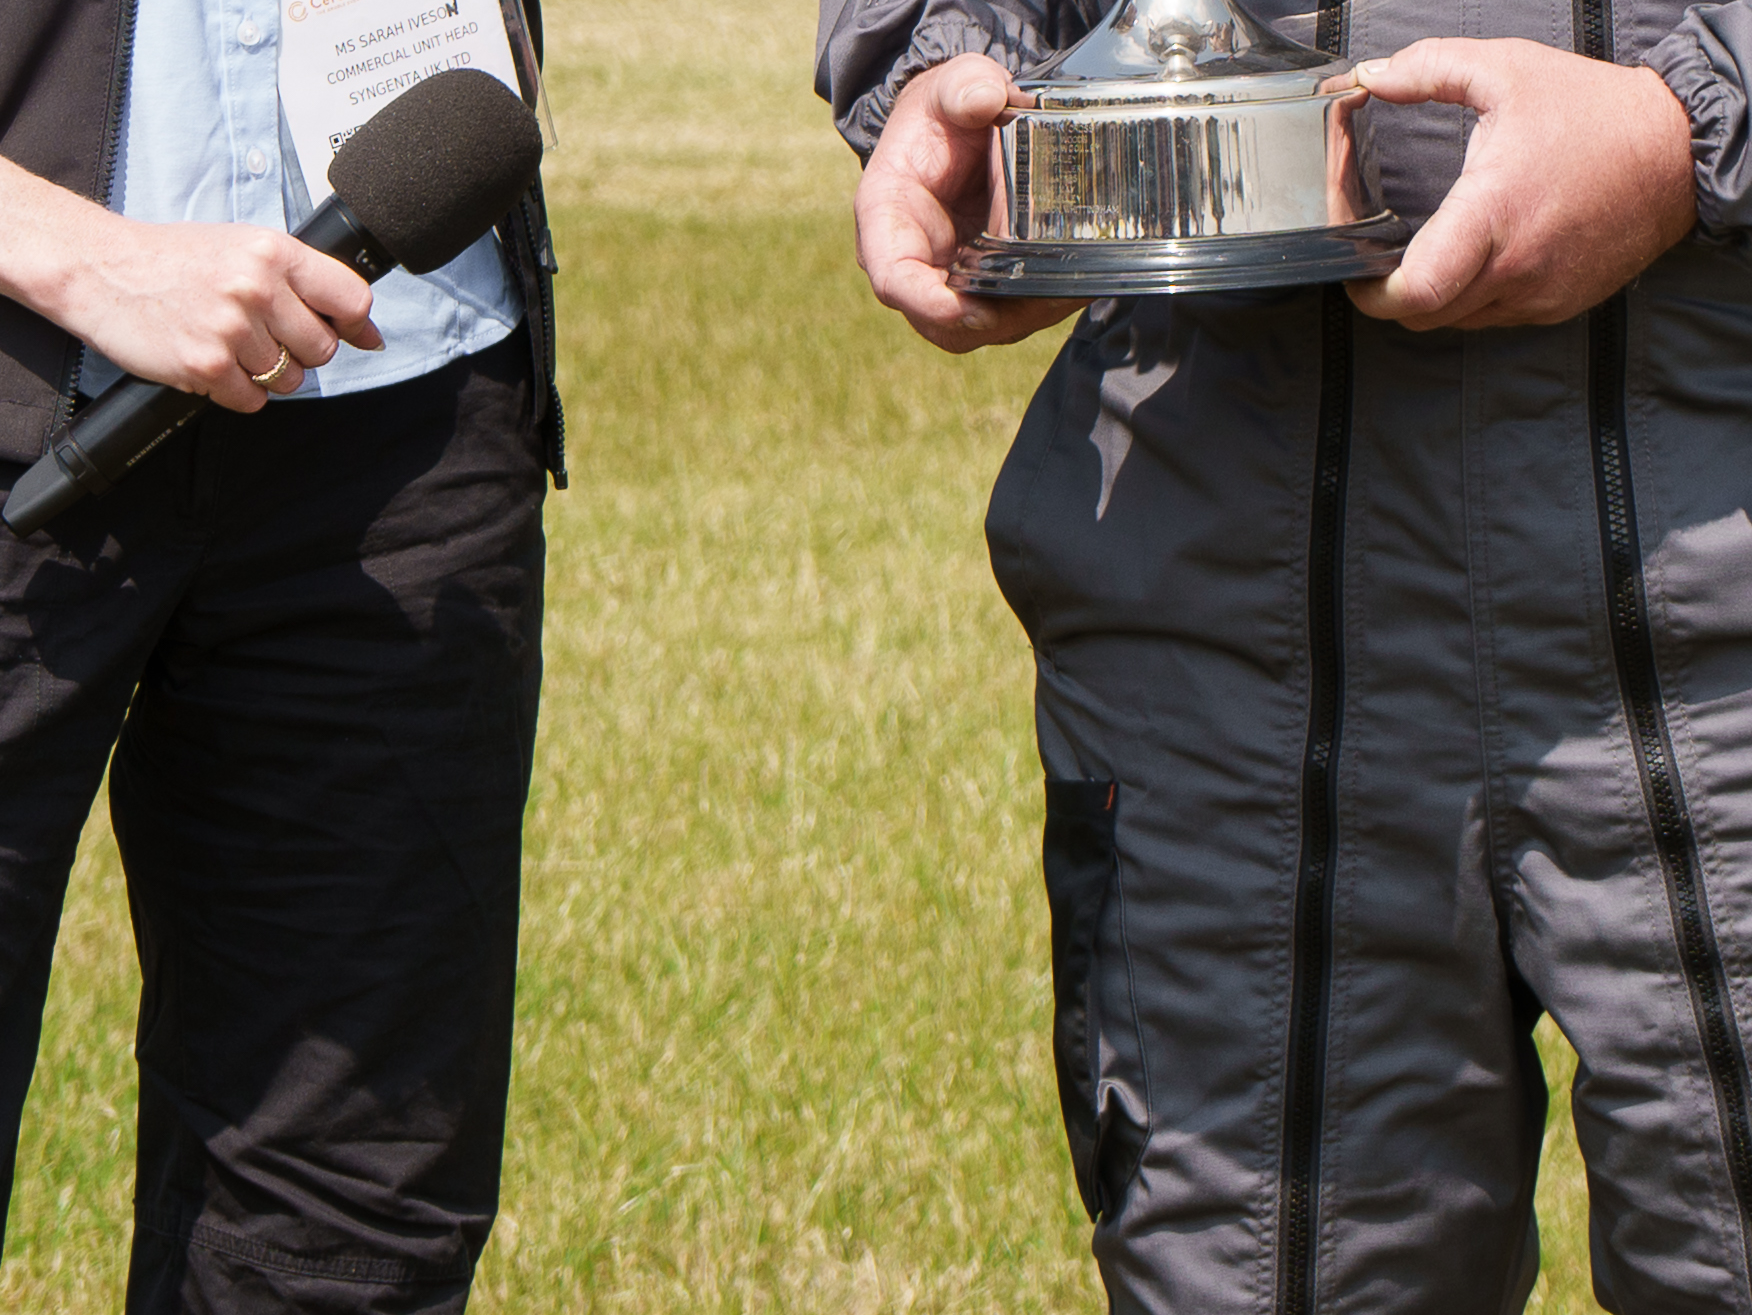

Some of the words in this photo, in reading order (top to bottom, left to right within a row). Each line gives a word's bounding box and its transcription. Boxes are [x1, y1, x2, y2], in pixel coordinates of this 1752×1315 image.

[327, 47, 411, 85] COMMERCIAL
[413, 34, 441, 55] UNIT
[445, 21, 479, 43] HEAD
[335, 38, 356, 56] MS
[359, 21, 405, 49] SARAH
[349, 70, 422, 105] SYNGENTA
[424, 60, 446, 78] UK
[446, 51, 471, 71] LTD
